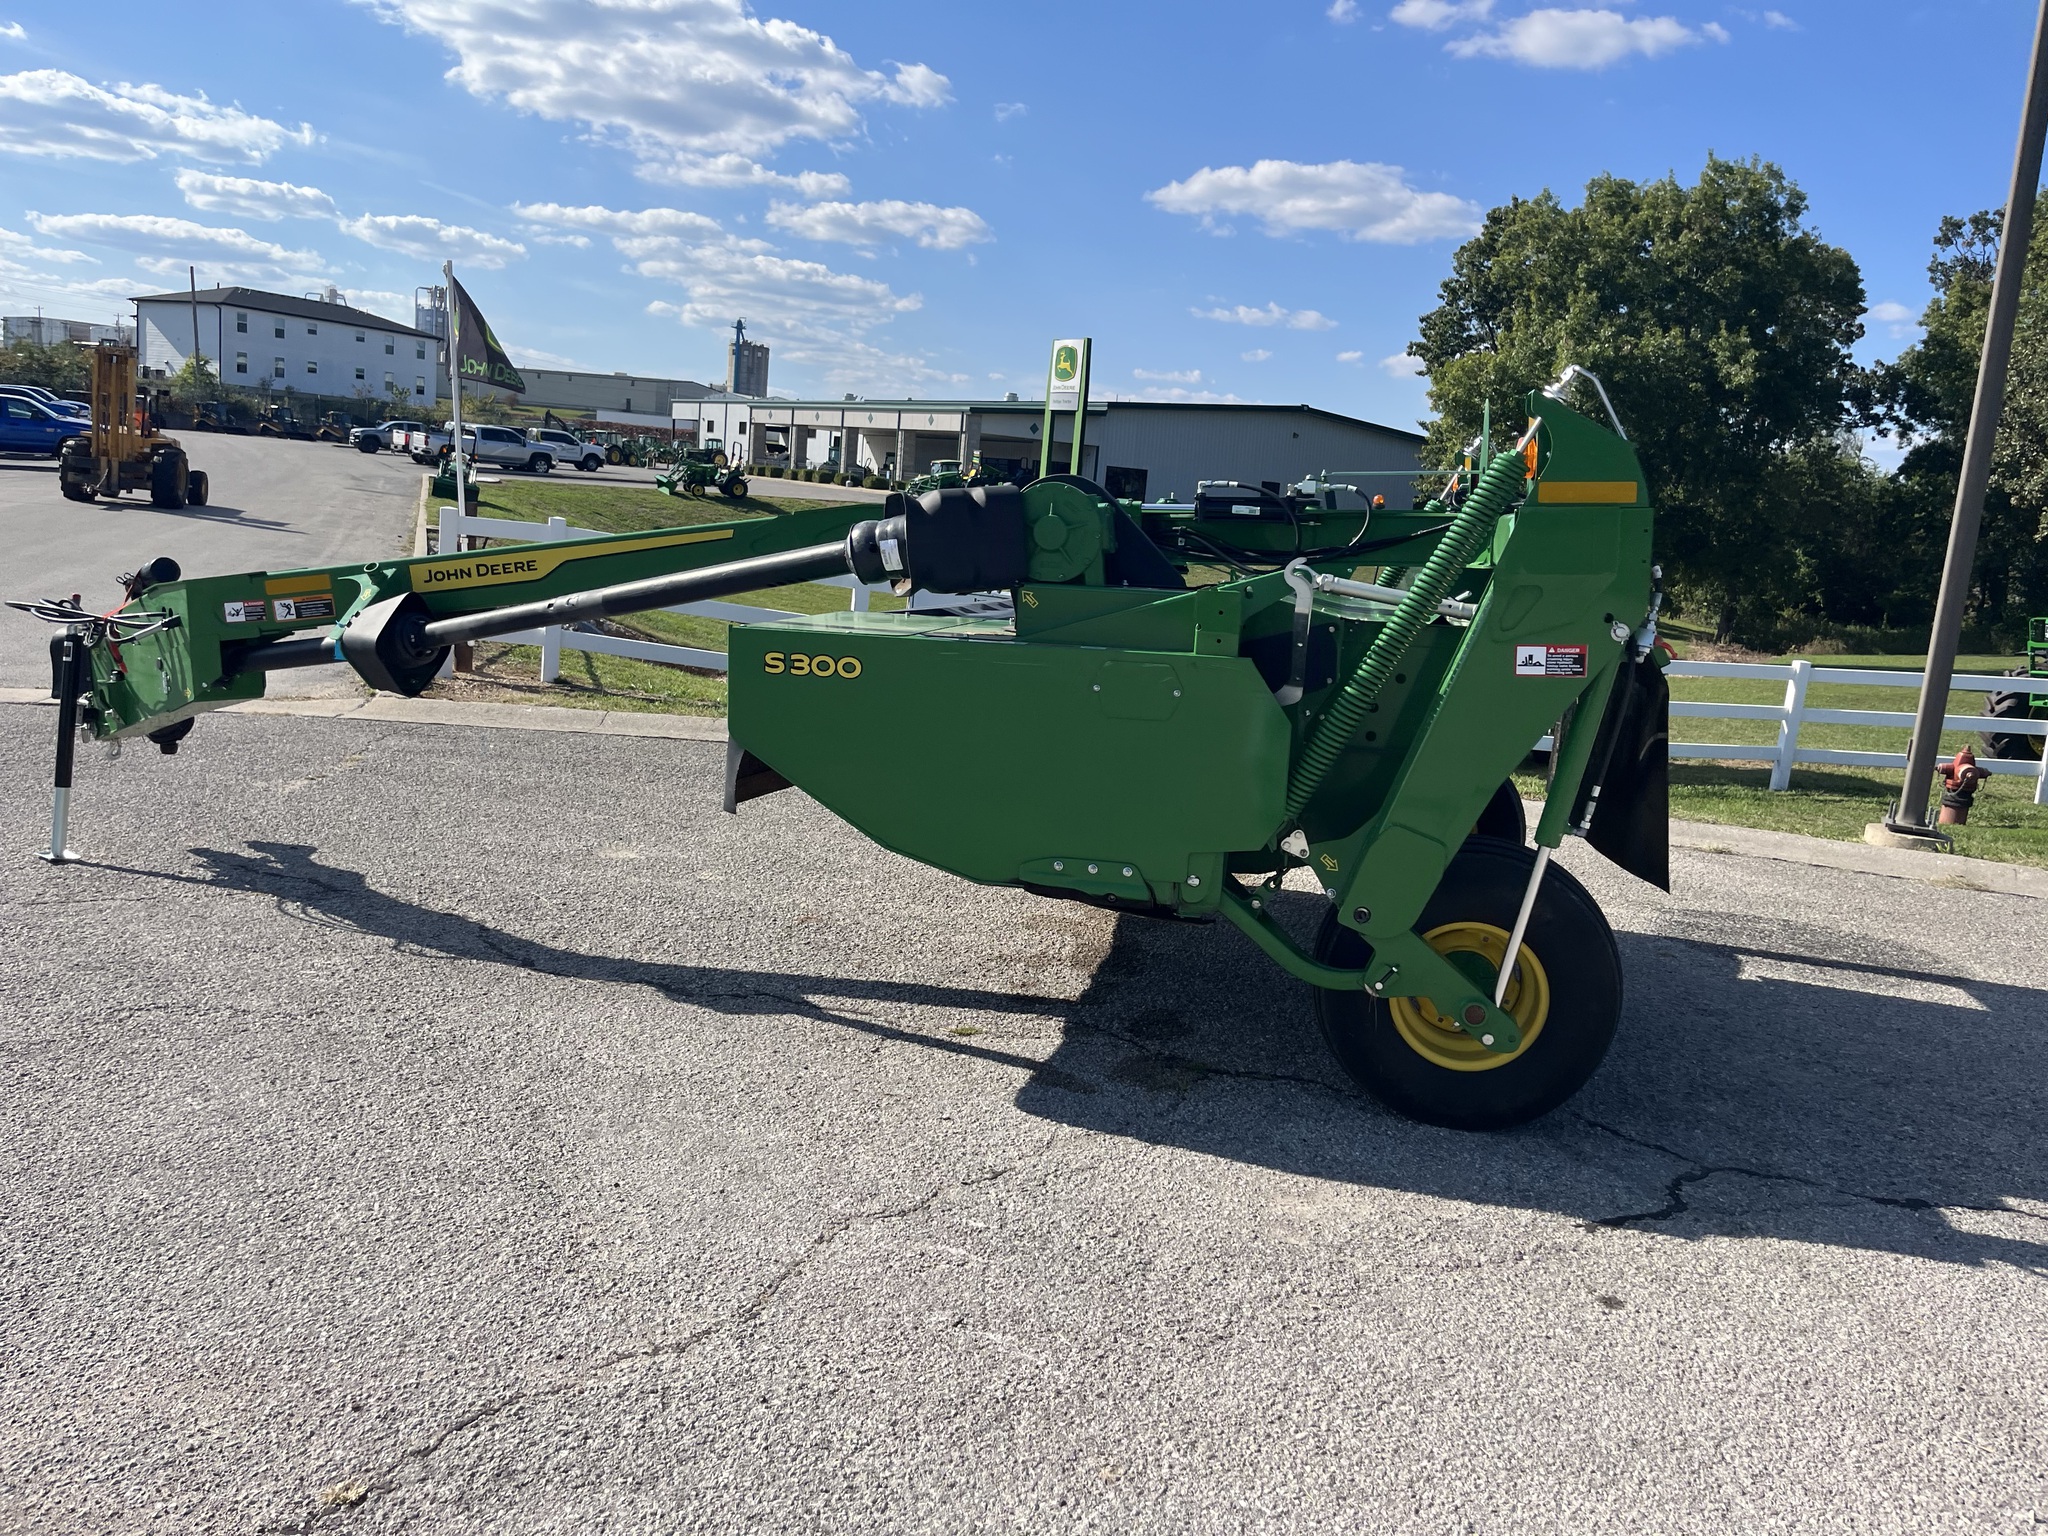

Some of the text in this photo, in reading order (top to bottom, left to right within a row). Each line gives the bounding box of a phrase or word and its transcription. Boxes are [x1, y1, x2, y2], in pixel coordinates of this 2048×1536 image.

[423, 559, 538, 584] JOHN DEERE
[789, 651, 863, 680] 300
